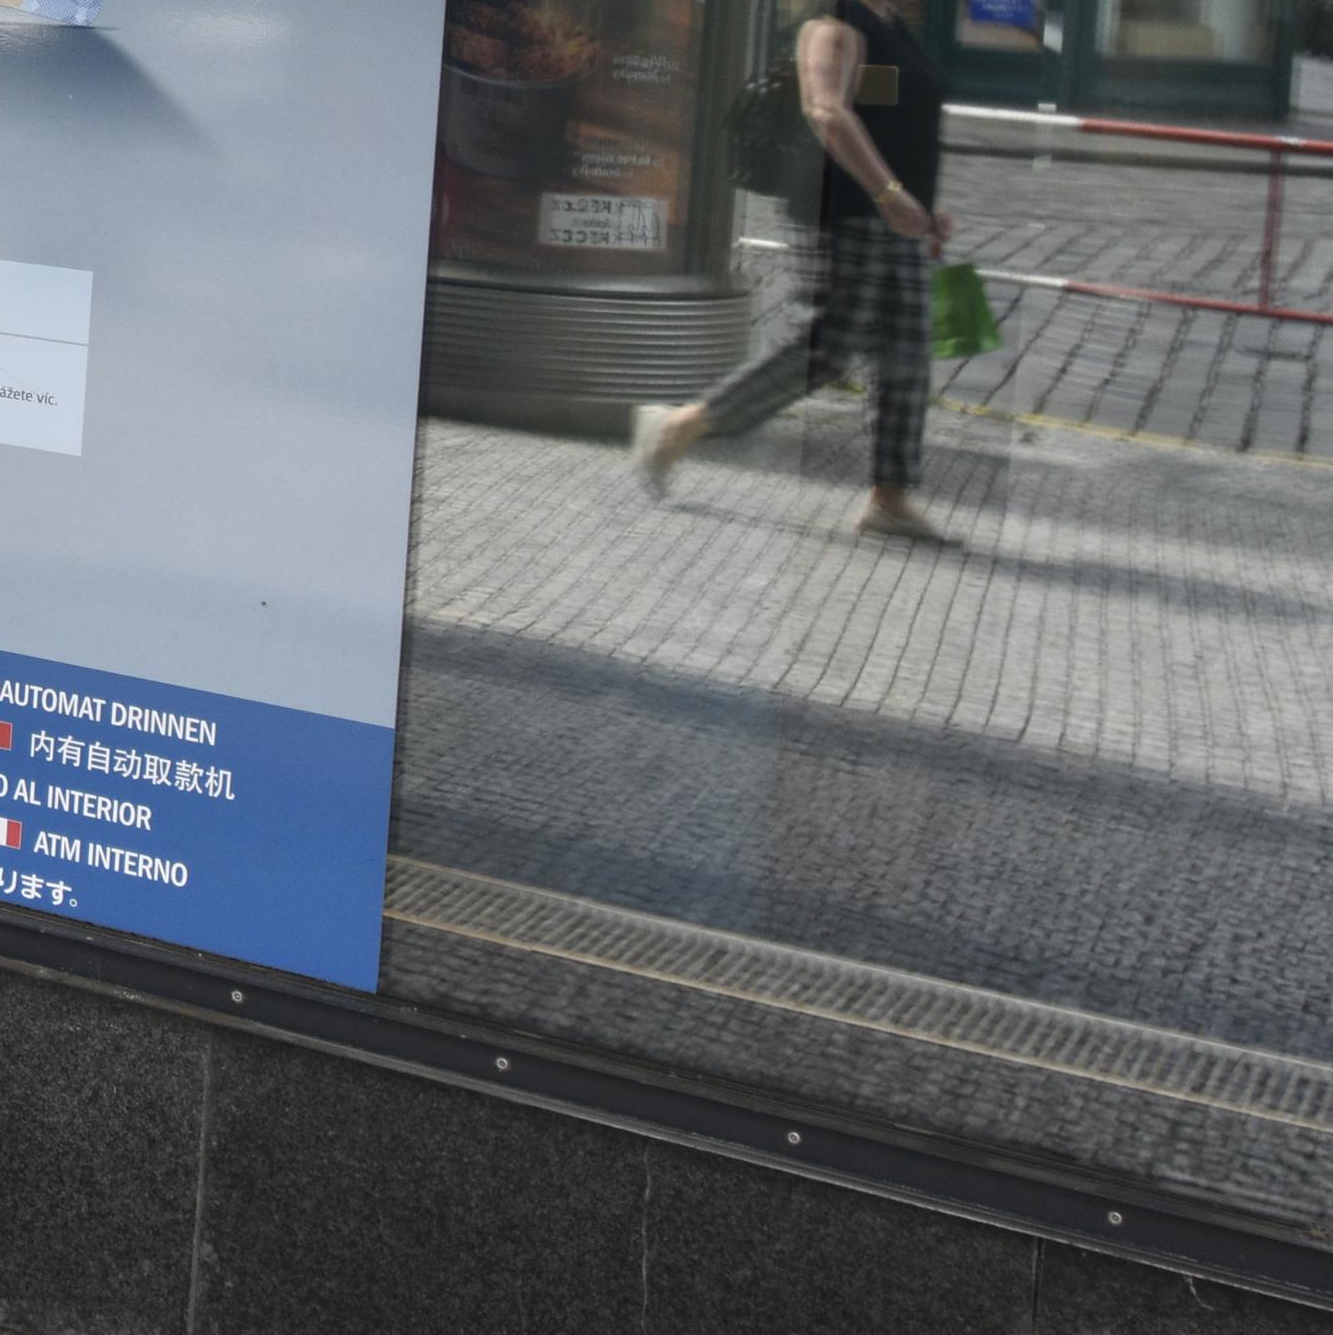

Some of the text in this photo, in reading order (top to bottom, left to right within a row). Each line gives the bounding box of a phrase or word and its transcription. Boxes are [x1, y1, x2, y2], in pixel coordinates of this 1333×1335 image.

[36, 392, 58, 406] víc.
[110, 701, 218, 747] DRINNEN
[29, 729, 236, 801] 内有自动取款机
[13, 778, 42, 807] AL
[47, 785, 153, 831] INTERIOR
[33, 830, 189, 888] ATM INTERNO
